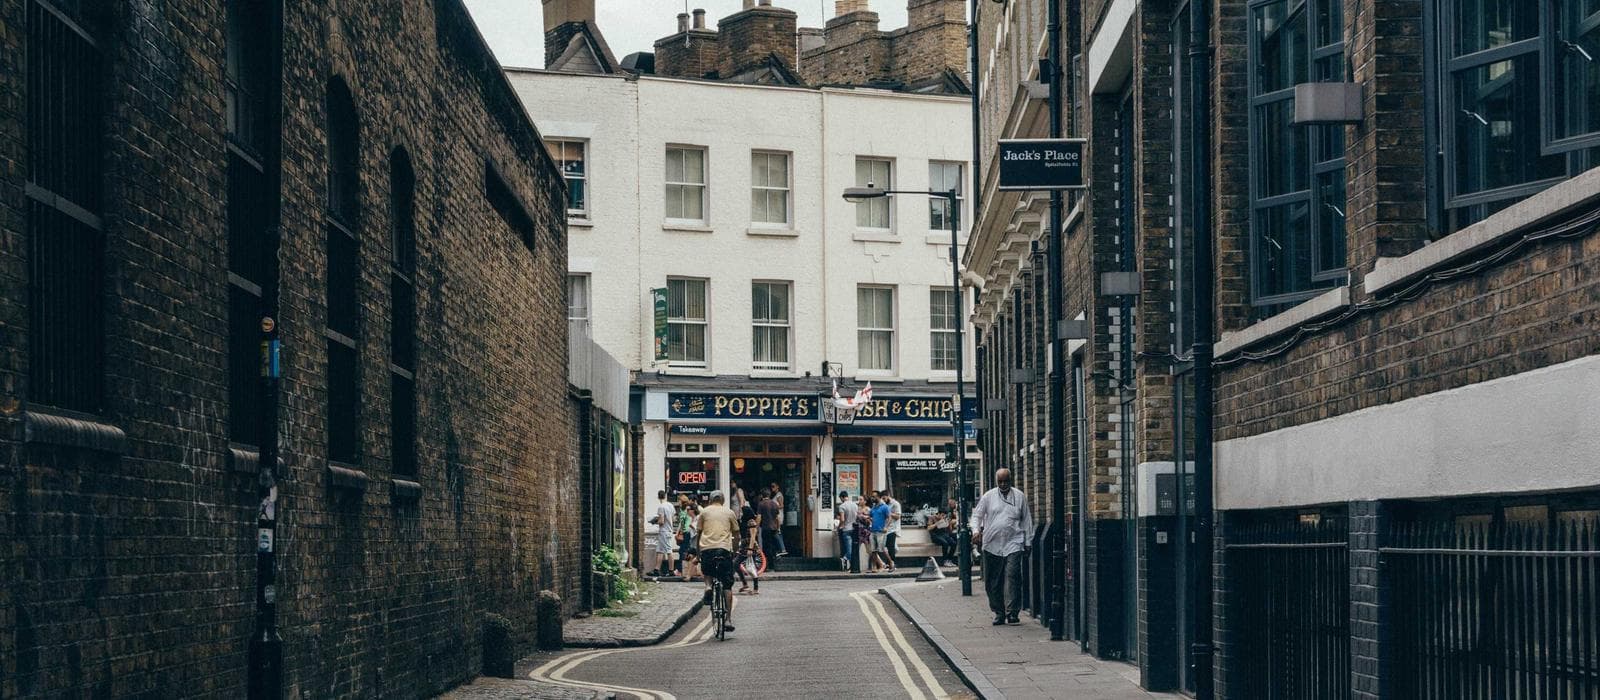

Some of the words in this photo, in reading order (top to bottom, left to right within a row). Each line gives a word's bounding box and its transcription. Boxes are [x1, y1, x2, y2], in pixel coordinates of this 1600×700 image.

[1003, 150, 1041, 161] Jack's
[1044, 150, 1079, 160] Place
[714, 395, 809, 417] POPPIE'S
[892, 402, 902, 414] &
[904, 399, 953, 418] CHIP
[678, 425, 707, 435] Takeaway
[680, 472, 705, 483] OPEN
